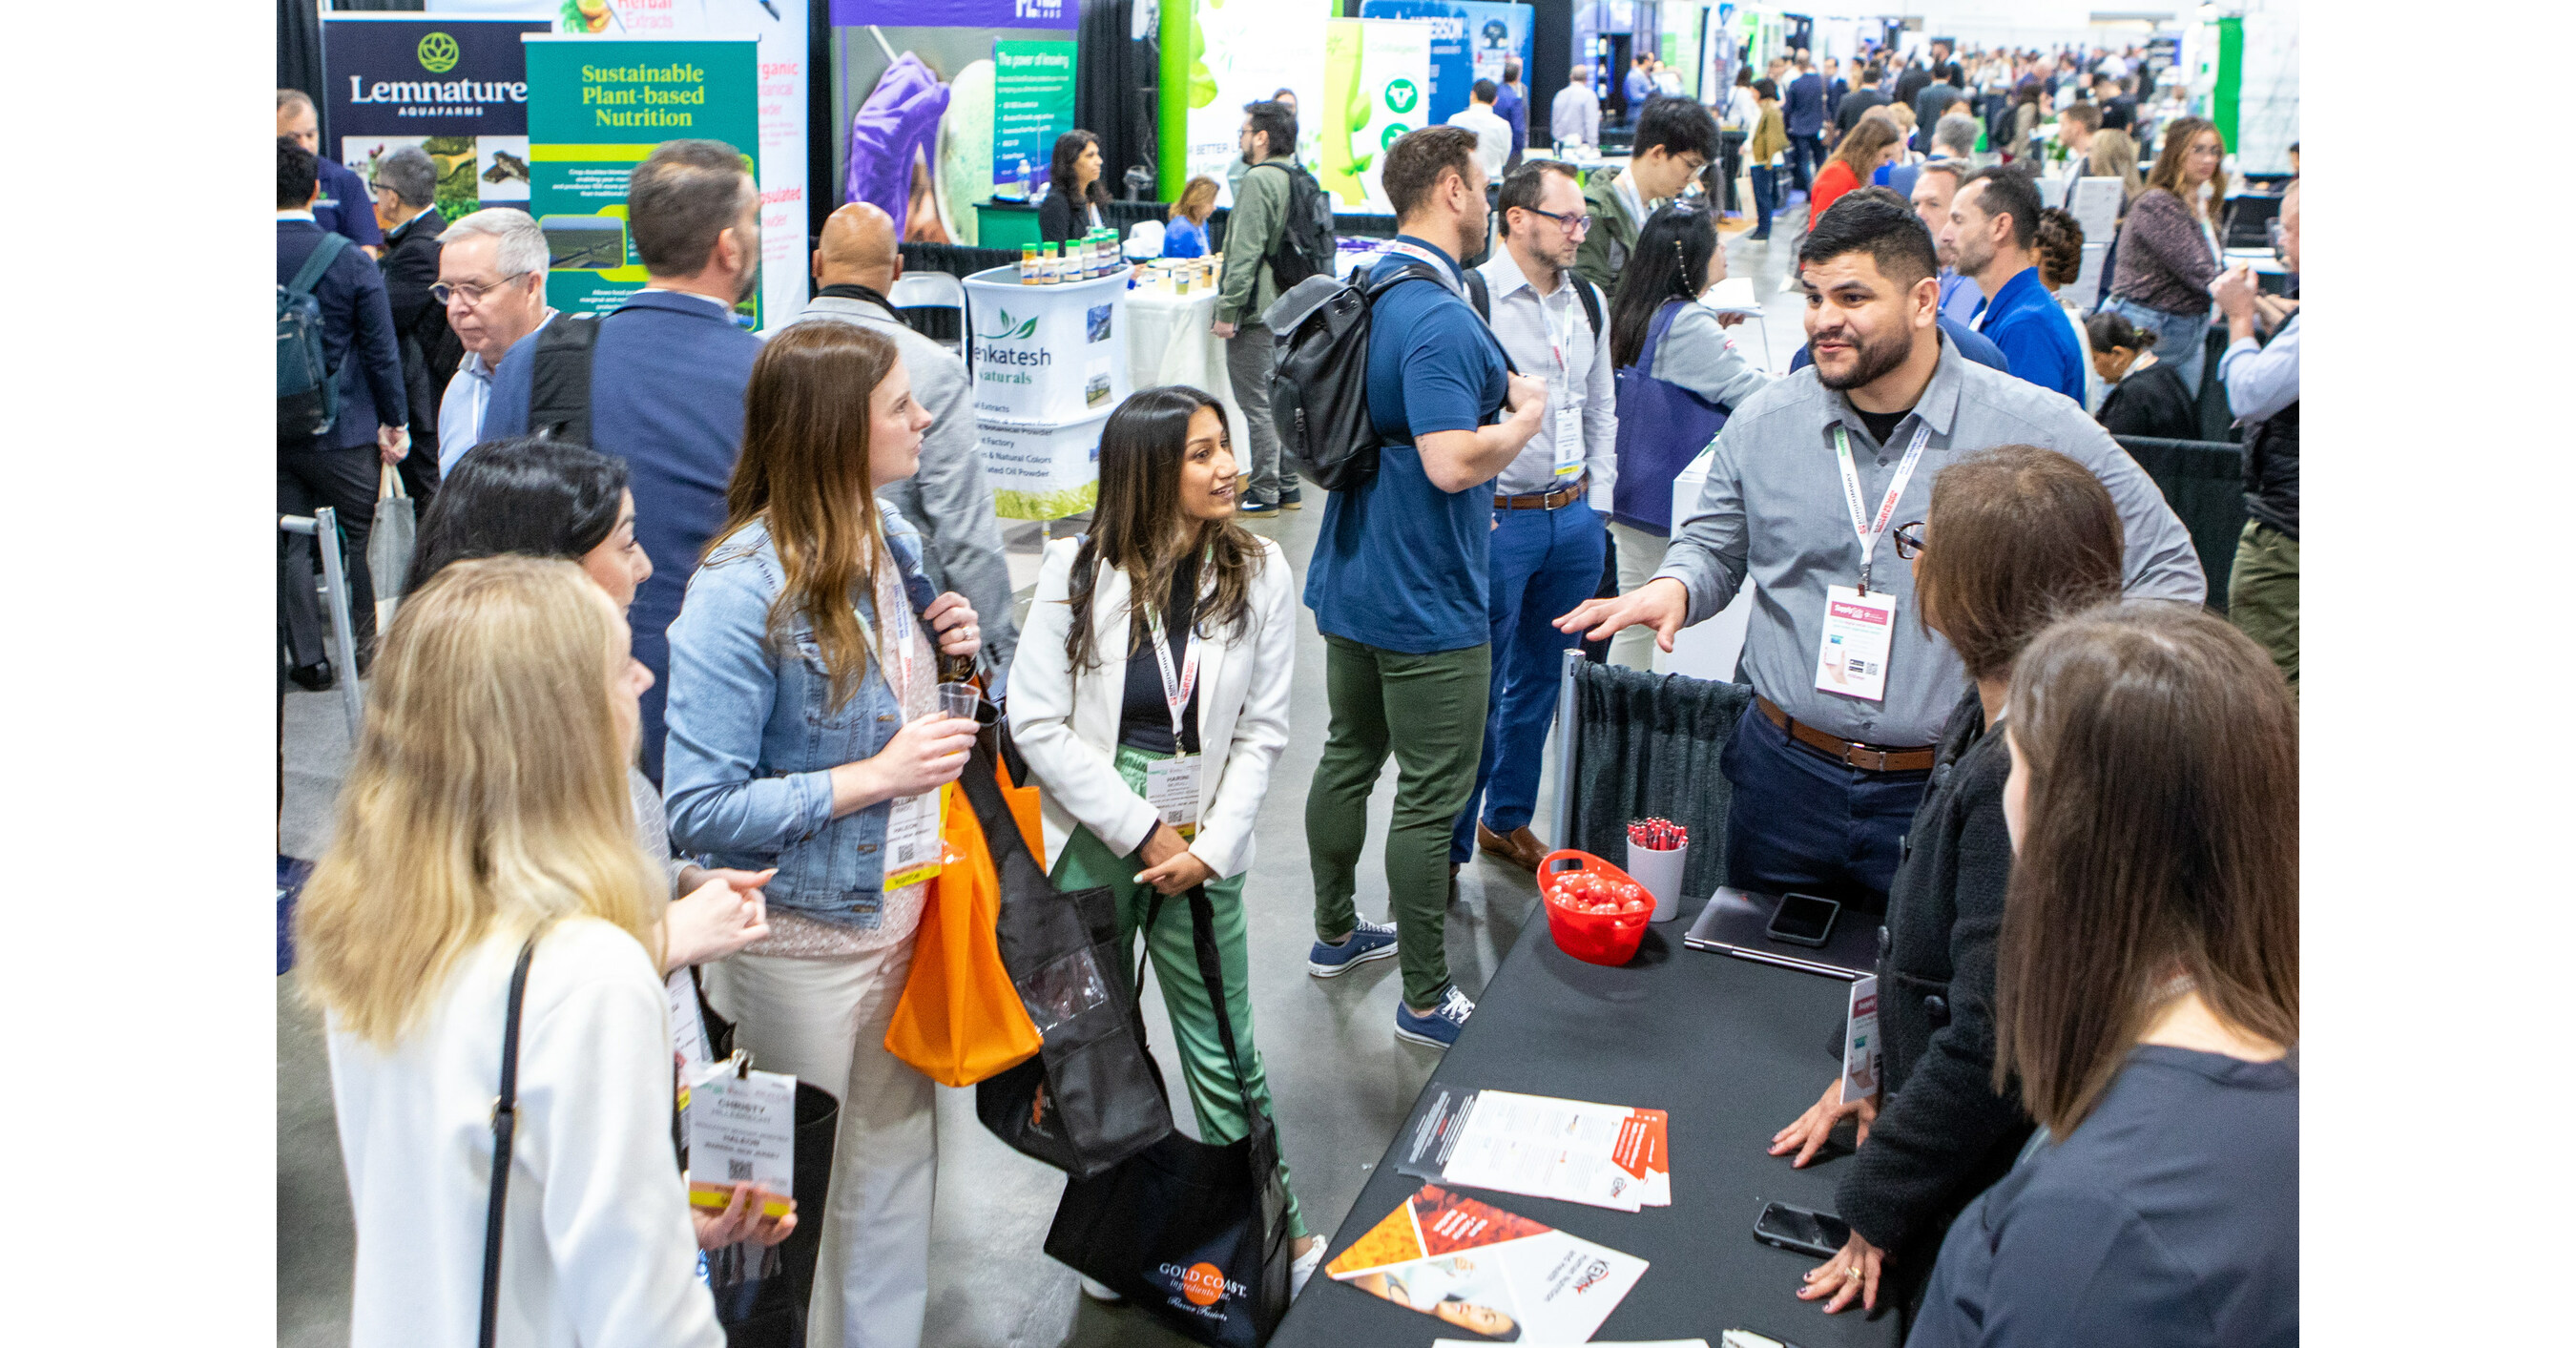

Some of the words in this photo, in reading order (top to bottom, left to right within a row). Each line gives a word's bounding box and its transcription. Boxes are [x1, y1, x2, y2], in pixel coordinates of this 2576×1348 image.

[582, 63, 704, 83] Sustainable
[758, 60, 800, 80] ganic
[349, 75, 527, 104] Lemnature
[582, 85, 704, 105] Plant-based
[398, 106, 484, 117] AQUAFARMS
[595, 108, 693, 127] Nutrition
[974, 343, 1051, 366] enkatesh
[987, 437, 1015, 448] Factory
[995, 452, 1024, 463] Natural
[1026, 455, 1051, 465] Colors
[986, 467, 1003, 475] ated
[1005, 467, 1016, 475] Oil
[1018, 468, 1049, 478] Powder
[1159, 1262, 1201, 1282] GOLD
